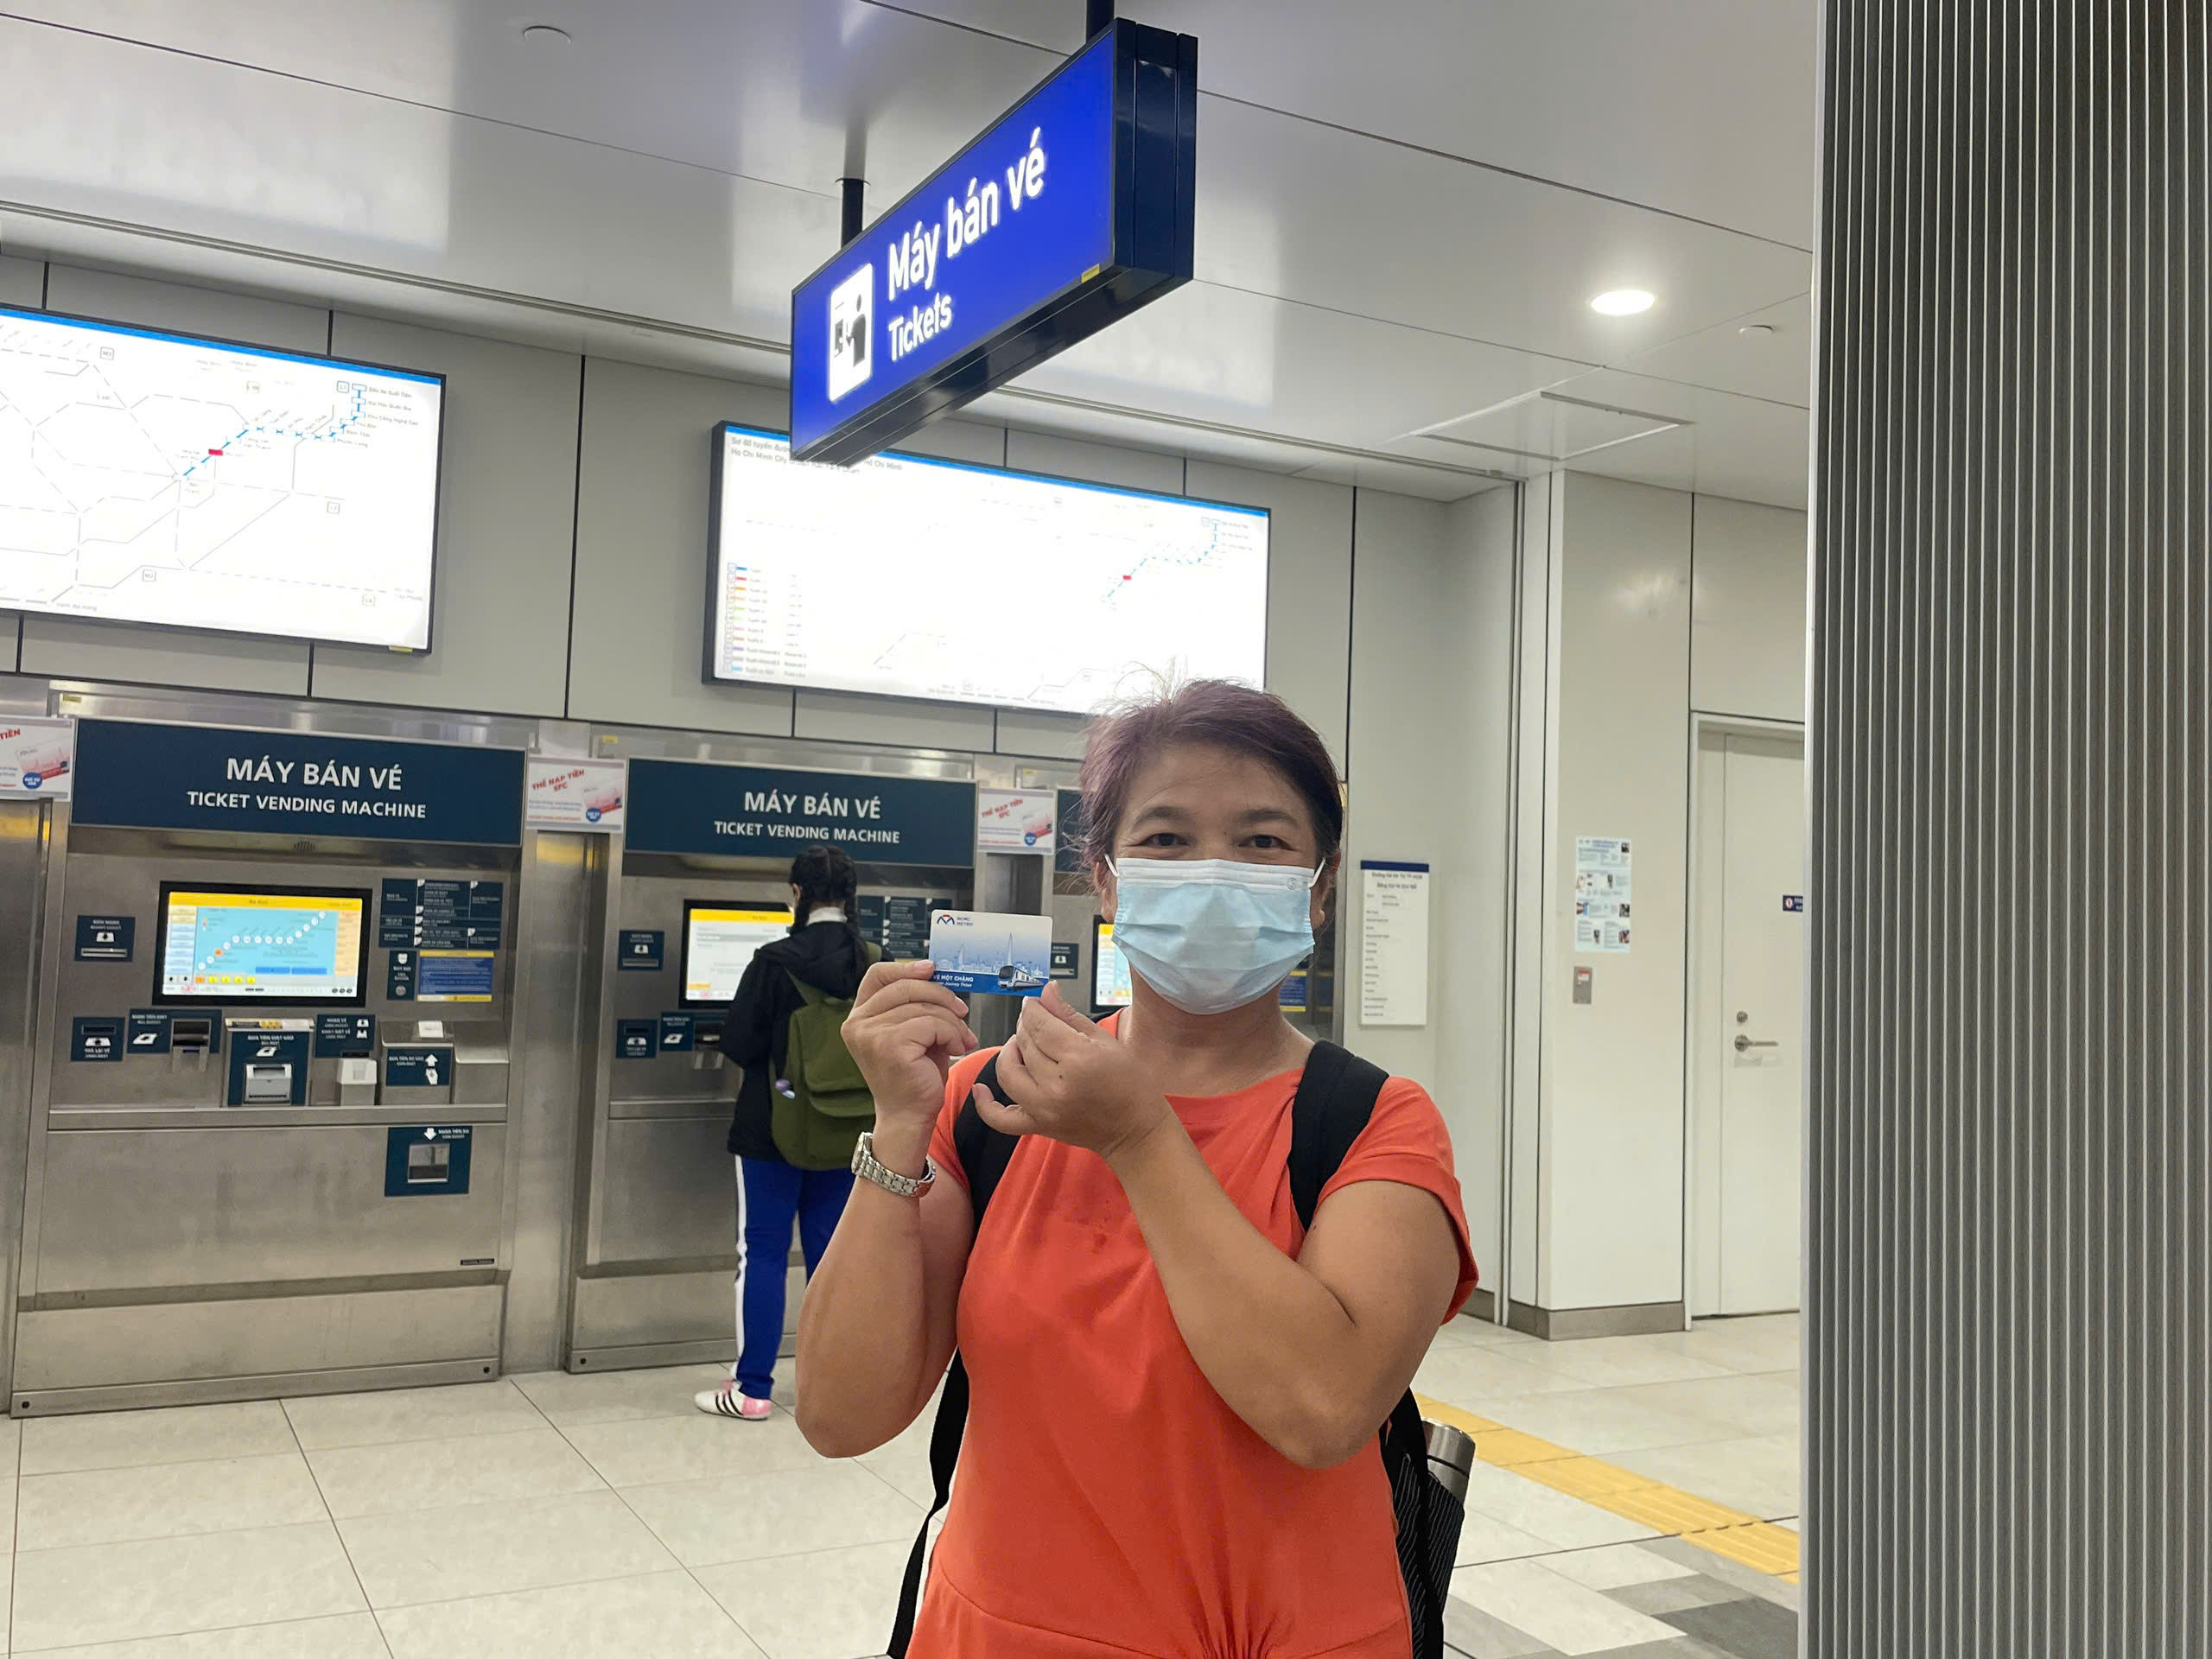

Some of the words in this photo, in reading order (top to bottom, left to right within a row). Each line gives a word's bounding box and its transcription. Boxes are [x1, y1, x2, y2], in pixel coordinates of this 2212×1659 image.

[888, 221, 939, 302] Máy
[947, 177, 999, 258] bán
[1007, 127, 1046, 212] vé
[888, 294, 952, 361] Tickets
[227, 755, 295, 784] MÁY
[303, 758, 359, 787] BÁN
[370, 763, 403, 791] VÉ
[188, 791, 251, 809] TICKET
[256, 795, 335, 814] VENDING
[342, 799, 426, 818] MACHINE
[744, 790, 797, 814] MÁY
[804, 792, 849, 817] BÁN
[855, 795, 881, 819] VÉ
[714, 821, 763, 836] TICKET
[767, 823, 830, 841] VENDING
[834, 828, 900, 844] MACHINE
